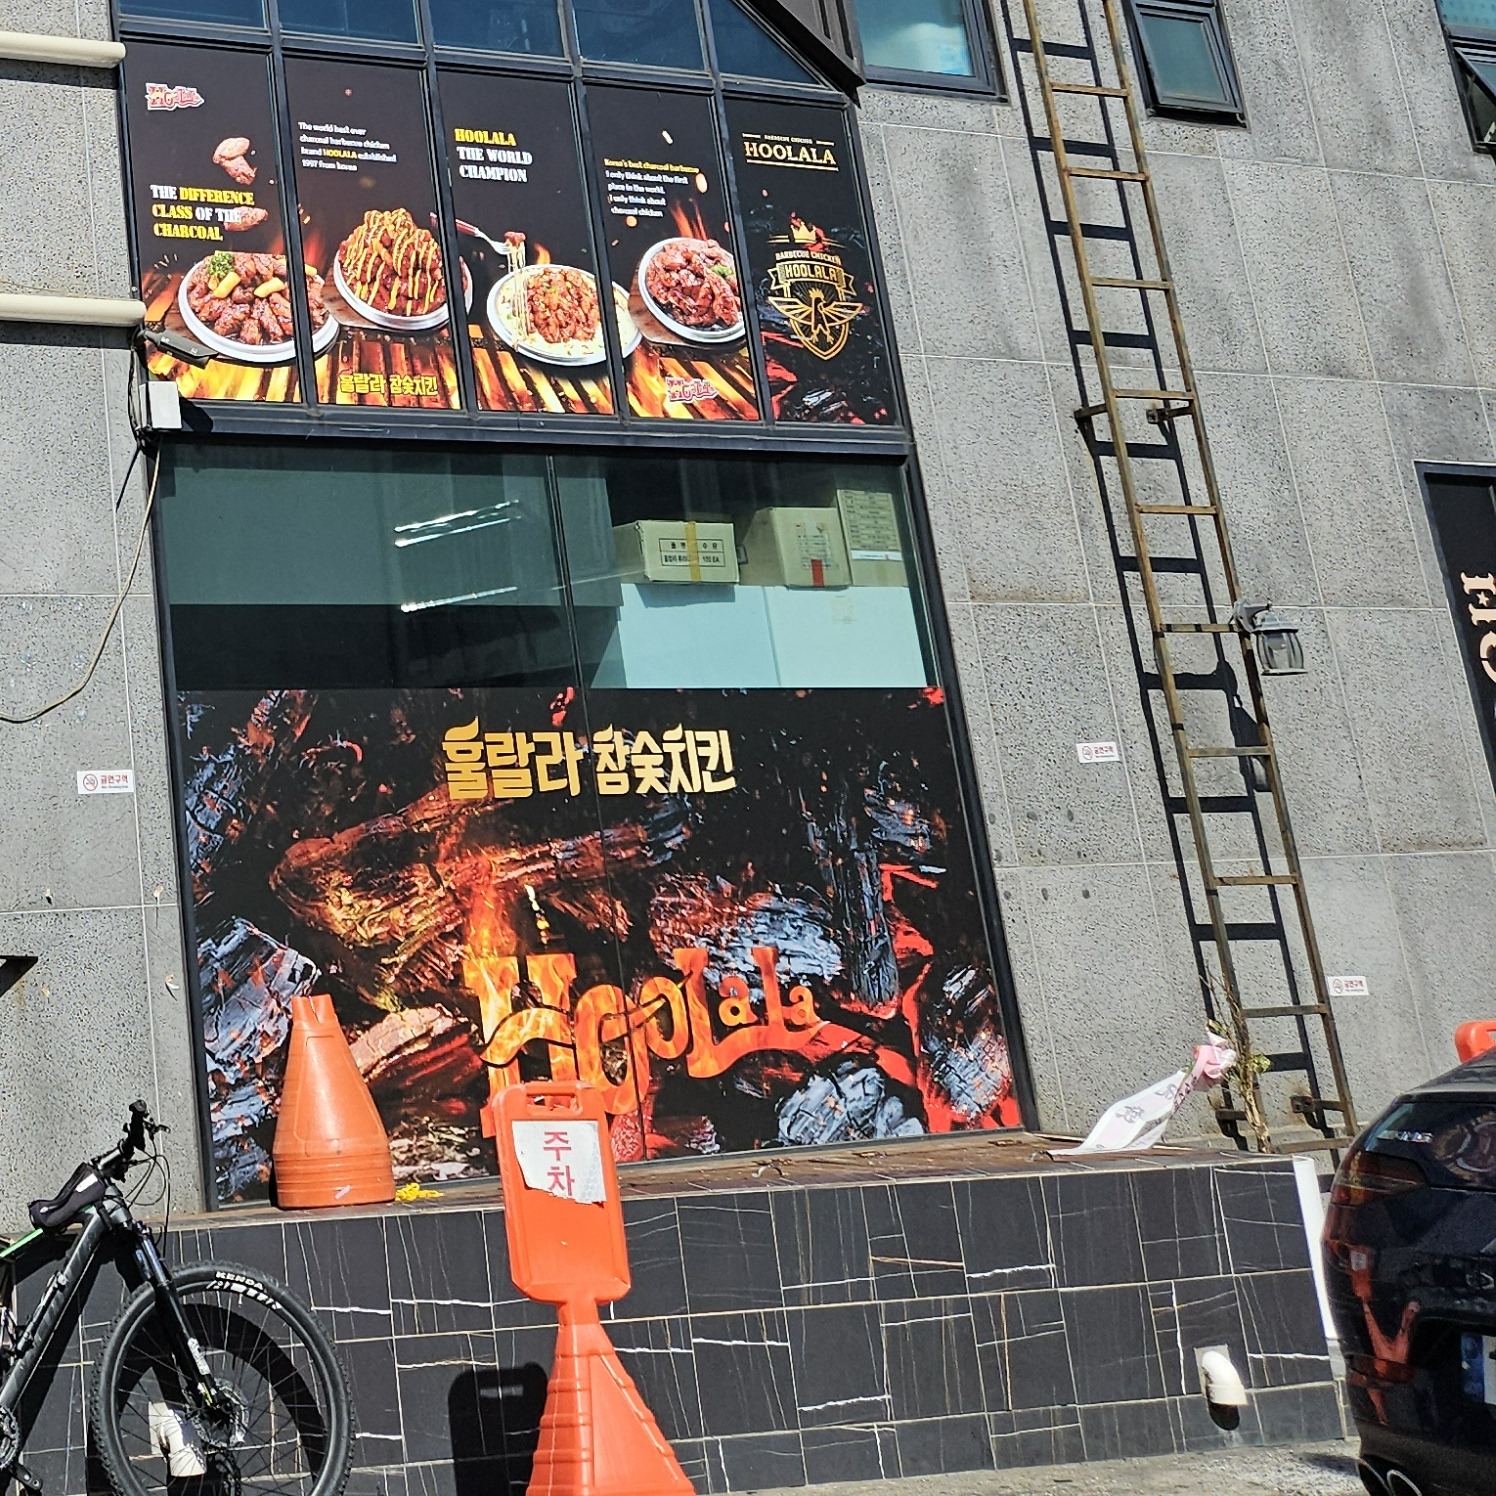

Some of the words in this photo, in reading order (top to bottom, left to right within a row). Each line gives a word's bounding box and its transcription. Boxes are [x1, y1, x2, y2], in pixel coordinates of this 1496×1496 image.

[454, 128, 517, 147] HOOLALA
[457, 146, 484, 161] THE
[486, 148, 533, 165] WORLD
[744, 141, 837, 165] HOOLALA
[459, 164, 527, 182] CHAMPION
[150, 185, 177, 200] THE
[179, 187, 254, 205] DIFFERENCE
[152, 204, 193, 220] CLASS
[195, 207, 213, 221] OF
[215, 207, 242, 223] THE
[153, 223, 223, 241] CHARCOAL
[785, 264, 838, 281] HOOLALA
[442, 715, 584, 800] 훌랄라
[592, 723, 737, 795] 참숯치킨
[100, 774, 129, 784] 금연구역
[543, 1130, 577, 1197] 주차
[215, 1270, 264, 1291] KENDA
